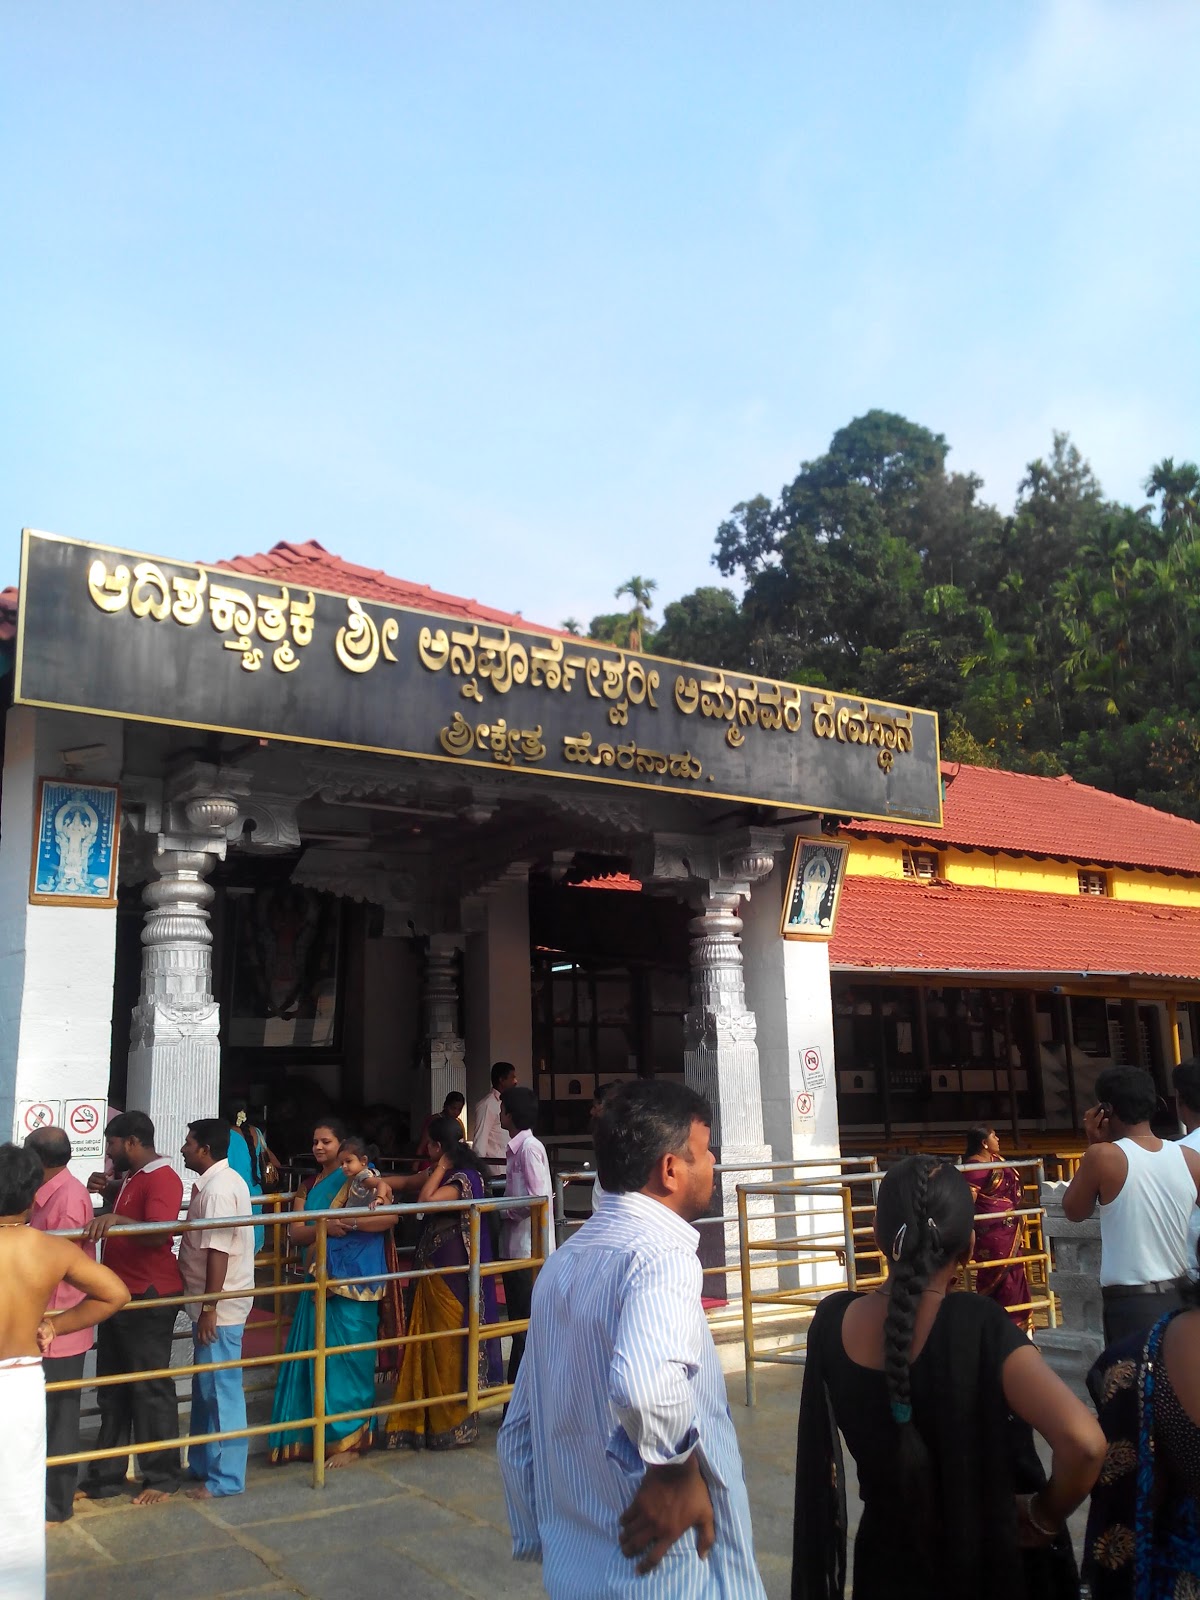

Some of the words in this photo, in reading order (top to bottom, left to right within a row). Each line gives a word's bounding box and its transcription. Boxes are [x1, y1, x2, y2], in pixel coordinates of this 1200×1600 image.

[335, 597, 399, 673] ಶ್ರೀ
[674, 672, 802, 748] ಅಮ್ಮನವರ
[811, 692, 914, 774] ದೇವಸ್ಥಾನ
